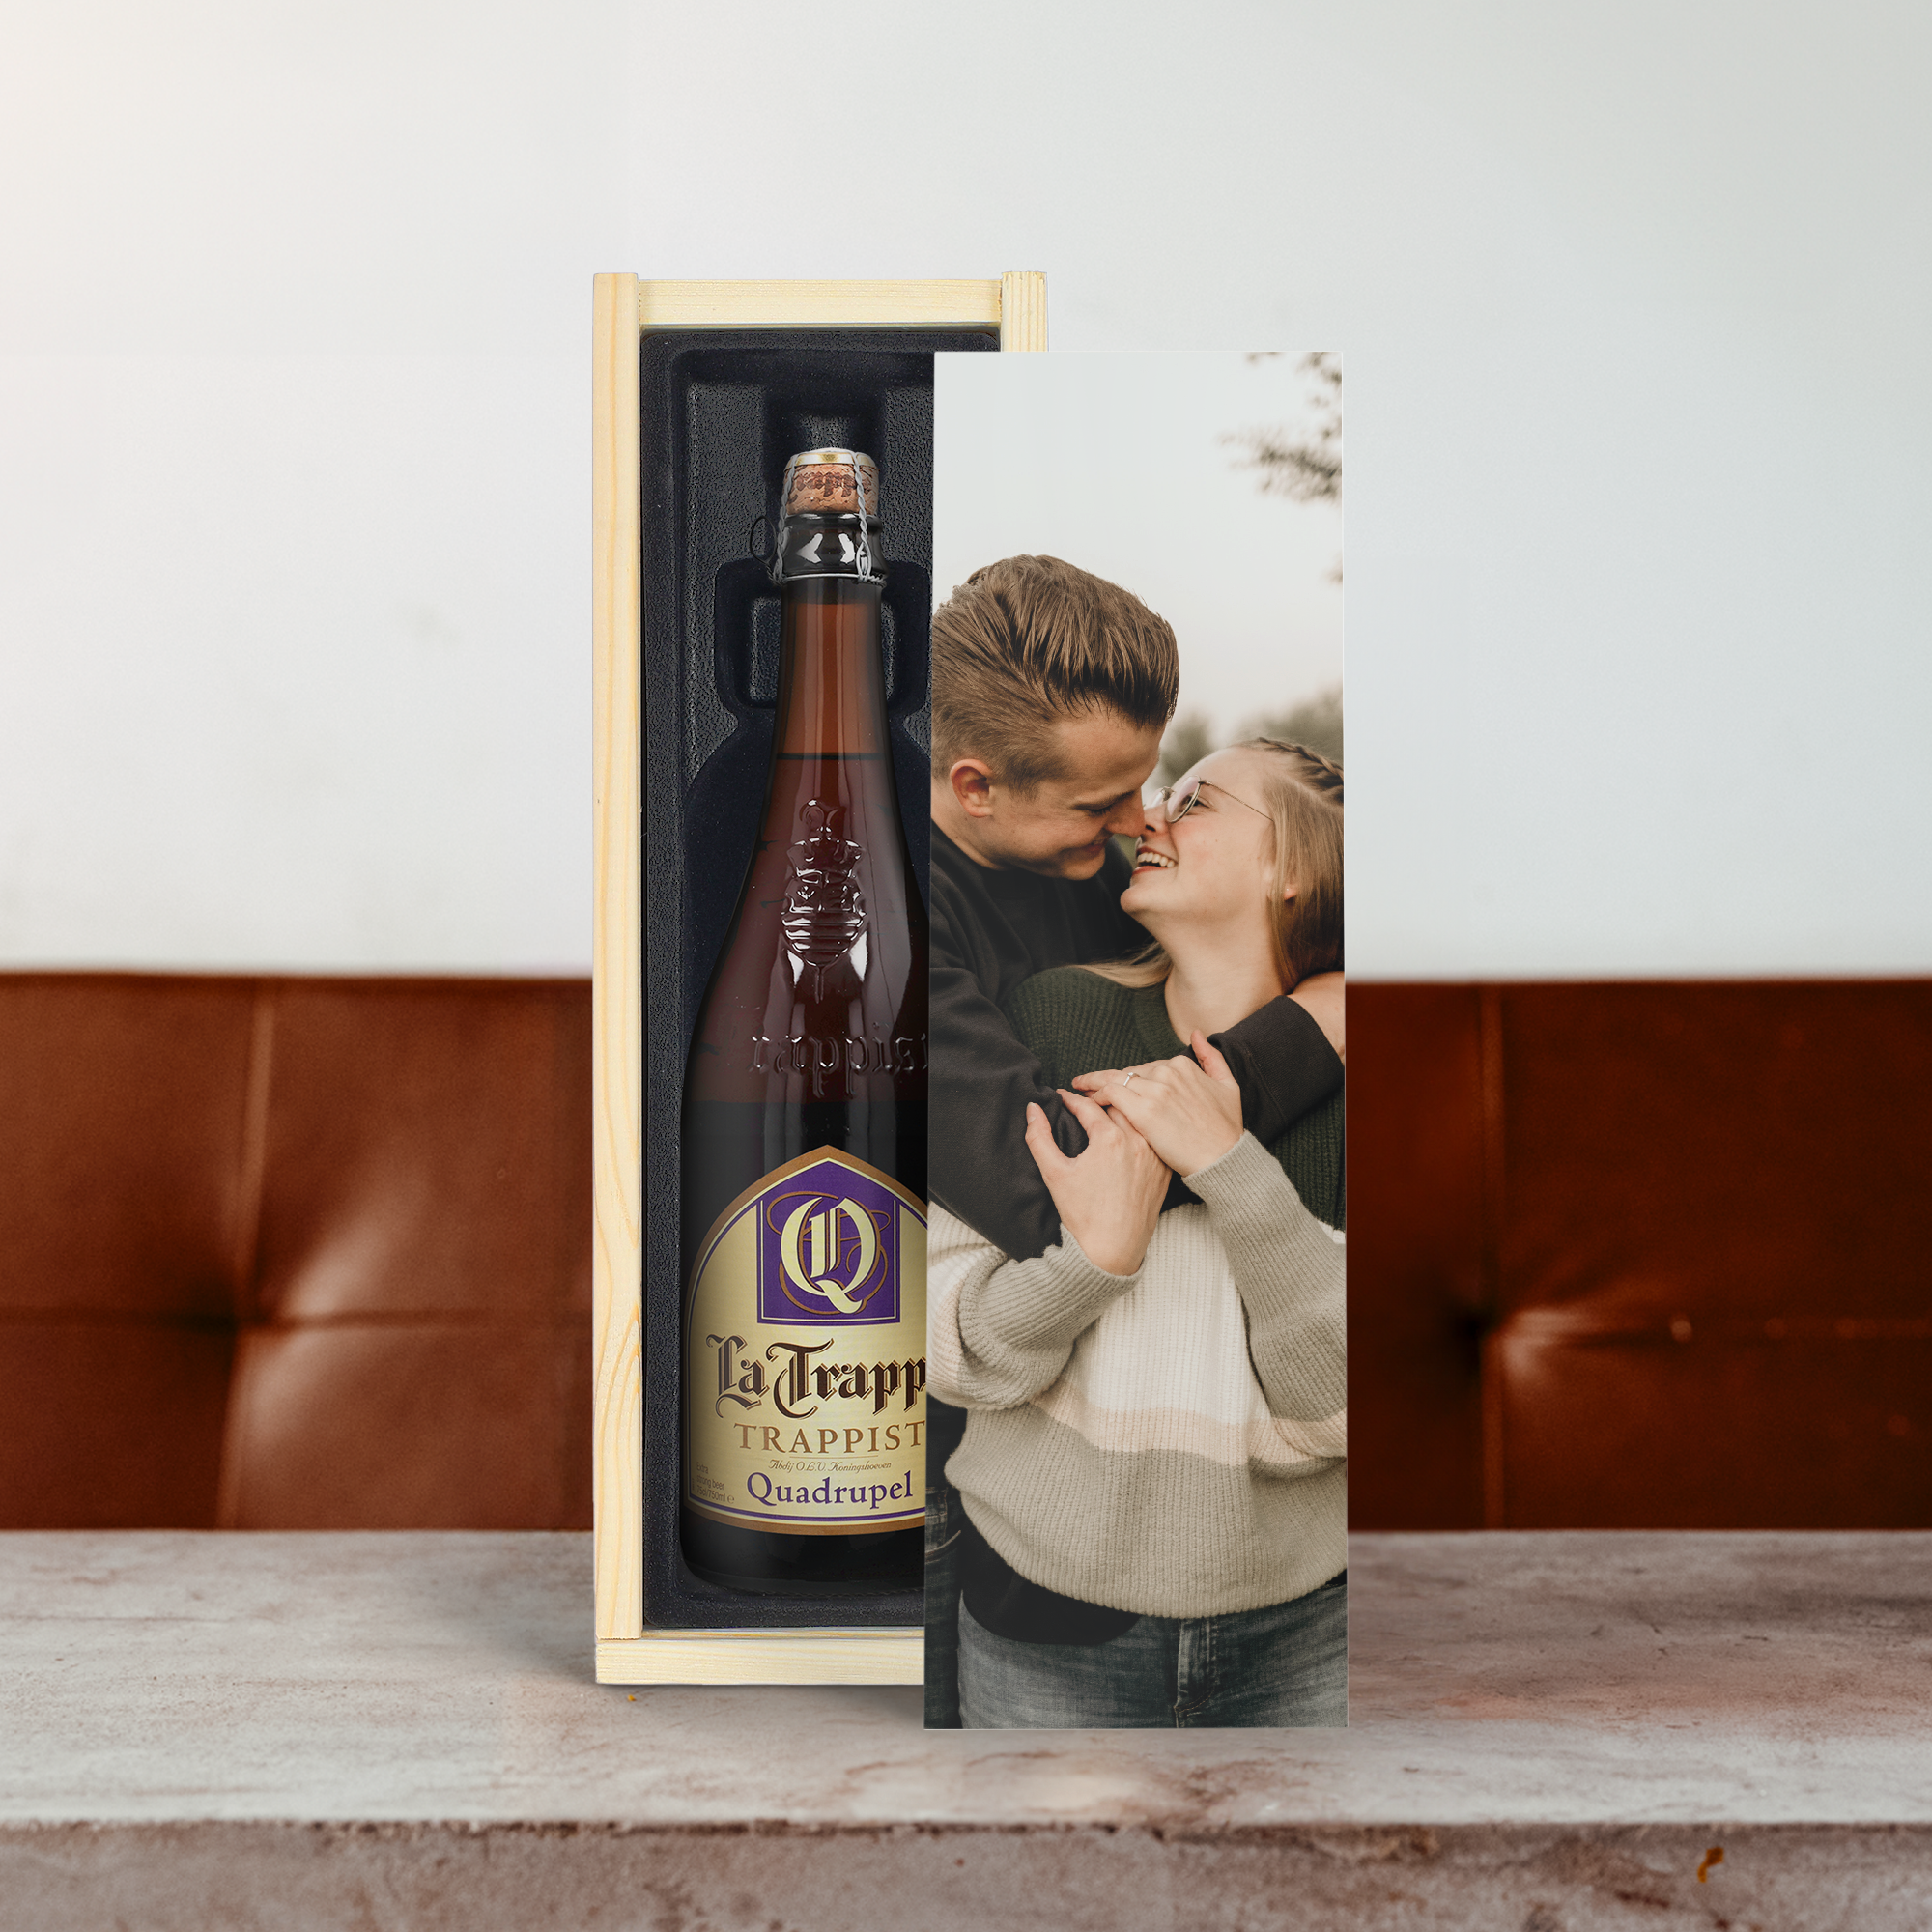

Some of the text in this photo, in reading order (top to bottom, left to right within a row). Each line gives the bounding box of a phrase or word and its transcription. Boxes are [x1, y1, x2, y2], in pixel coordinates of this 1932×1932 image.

[780, 1195, 881, 1314] Q
[705, 1333, 770, 1419] La
[733, 1420, 925, 1454] TRAPPIST
[696, 1462, 709, 1474] Extra
[696, 1474, 712, 1488] strong
[712, 1479, 725, 1491] beer
[768, 1459, 793, 1473] Abdij
[827, 1460, 892, 1474] Koningshoeven
[747, 1469, 914, 1510] Quadrupel
